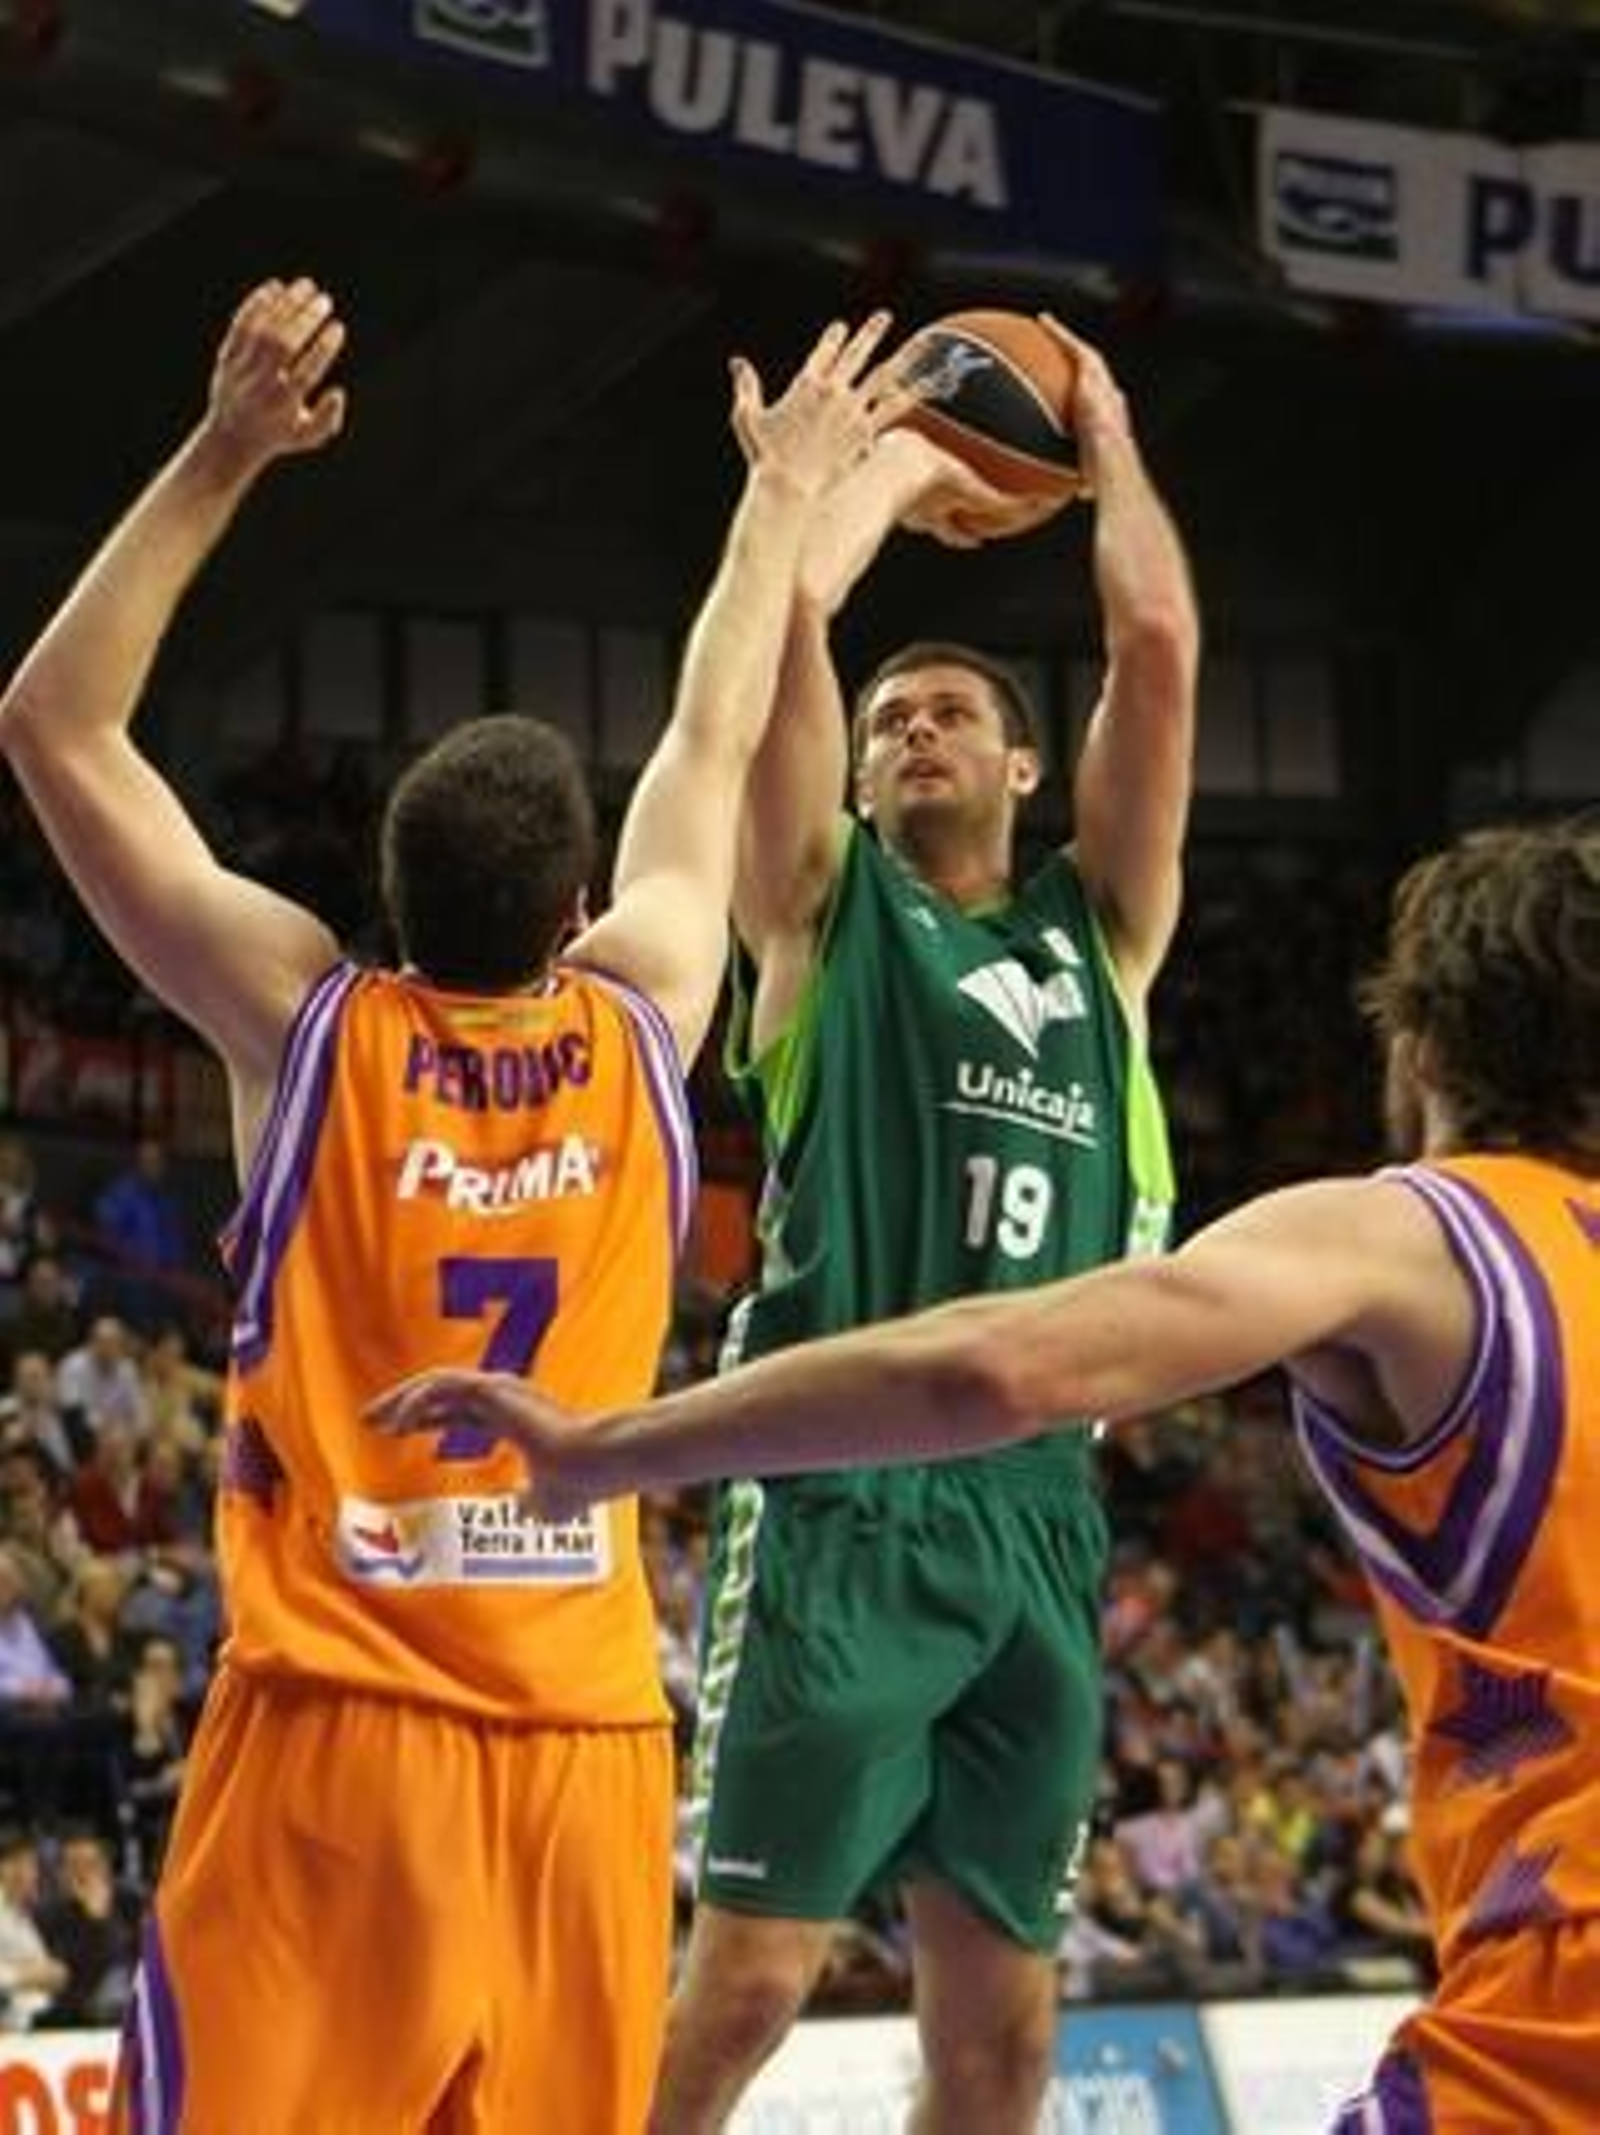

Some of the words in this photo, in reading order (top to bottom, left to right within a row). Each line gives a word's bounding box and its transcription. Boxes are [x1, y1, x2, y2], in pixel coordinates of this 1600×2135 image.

[587, 0, 1007, 208] PULEVA
[957, 1062, 1096, 1133] Unicaja
[396, 1134, 597, 1214] PRIMA
[965, 1155, 1053, 1259] 19
[436, 1257, 559, 1460] 7
